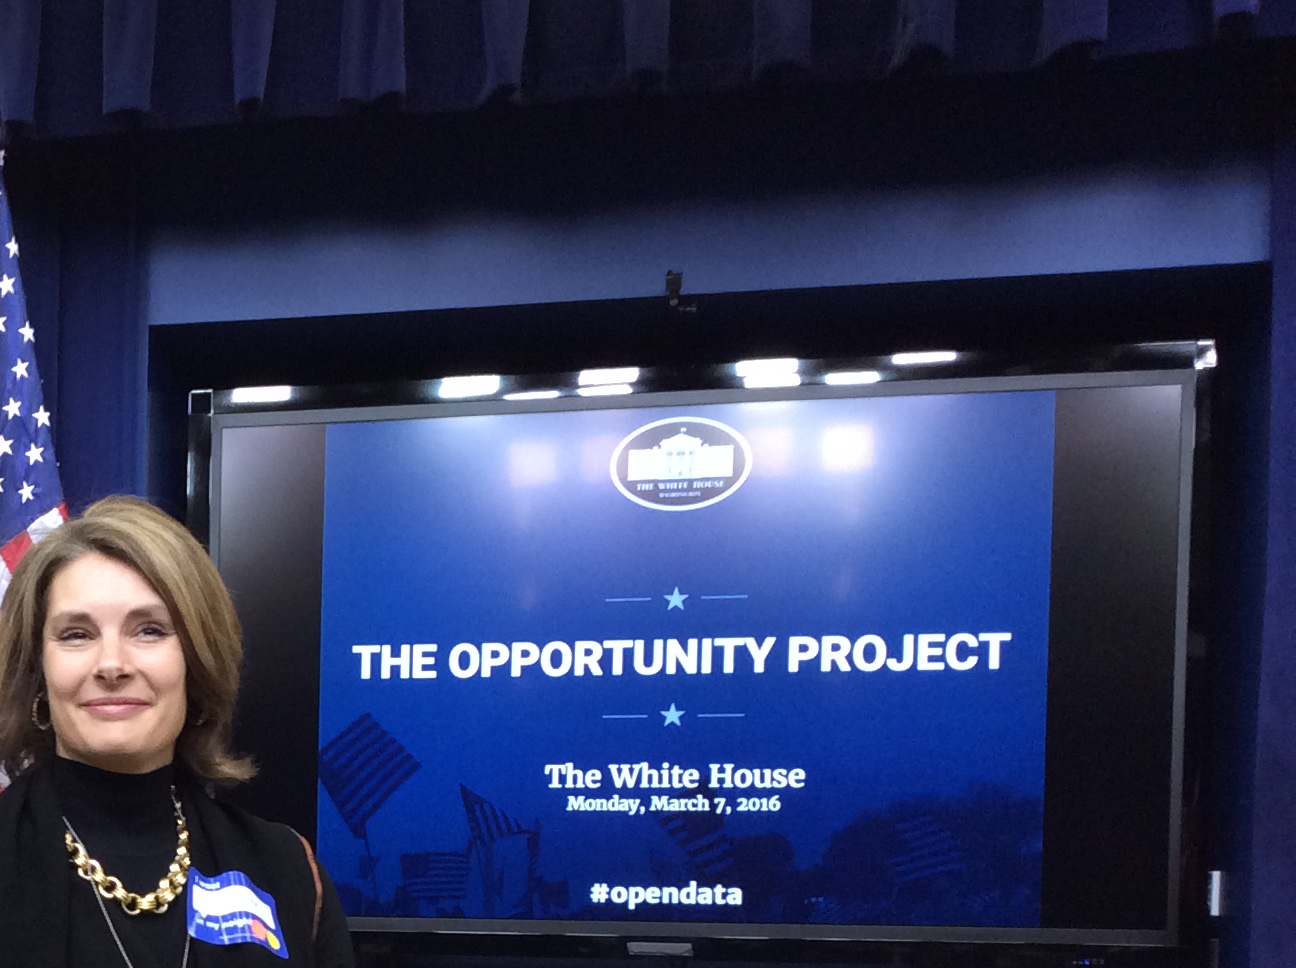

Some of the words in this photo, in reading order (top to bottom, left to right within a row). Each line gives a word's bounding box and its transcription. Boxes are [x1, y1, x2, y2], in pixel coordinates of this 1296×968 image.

[636, 482, 654, 491] THE
[657, 481, 688, 490] WHITE
[692, 480, 724, 489] HOUSE
[352, 644, 437, 679] THE
[448, 637, 776, 677] OPPORTUNITY
[787, 632, 1012, 673] PROJECT
[544, 762, 602, 788] The
[608, 762, 700, 788] White
[708, 763, 806, 788] House
[566, 795, 646, 815] Monday,
[649, 794, 710, 812] March
[713, 797, 732, 815] 7,
[736, 795, 781, 812] 2016
[590, 881, 743, 909] #opendata
